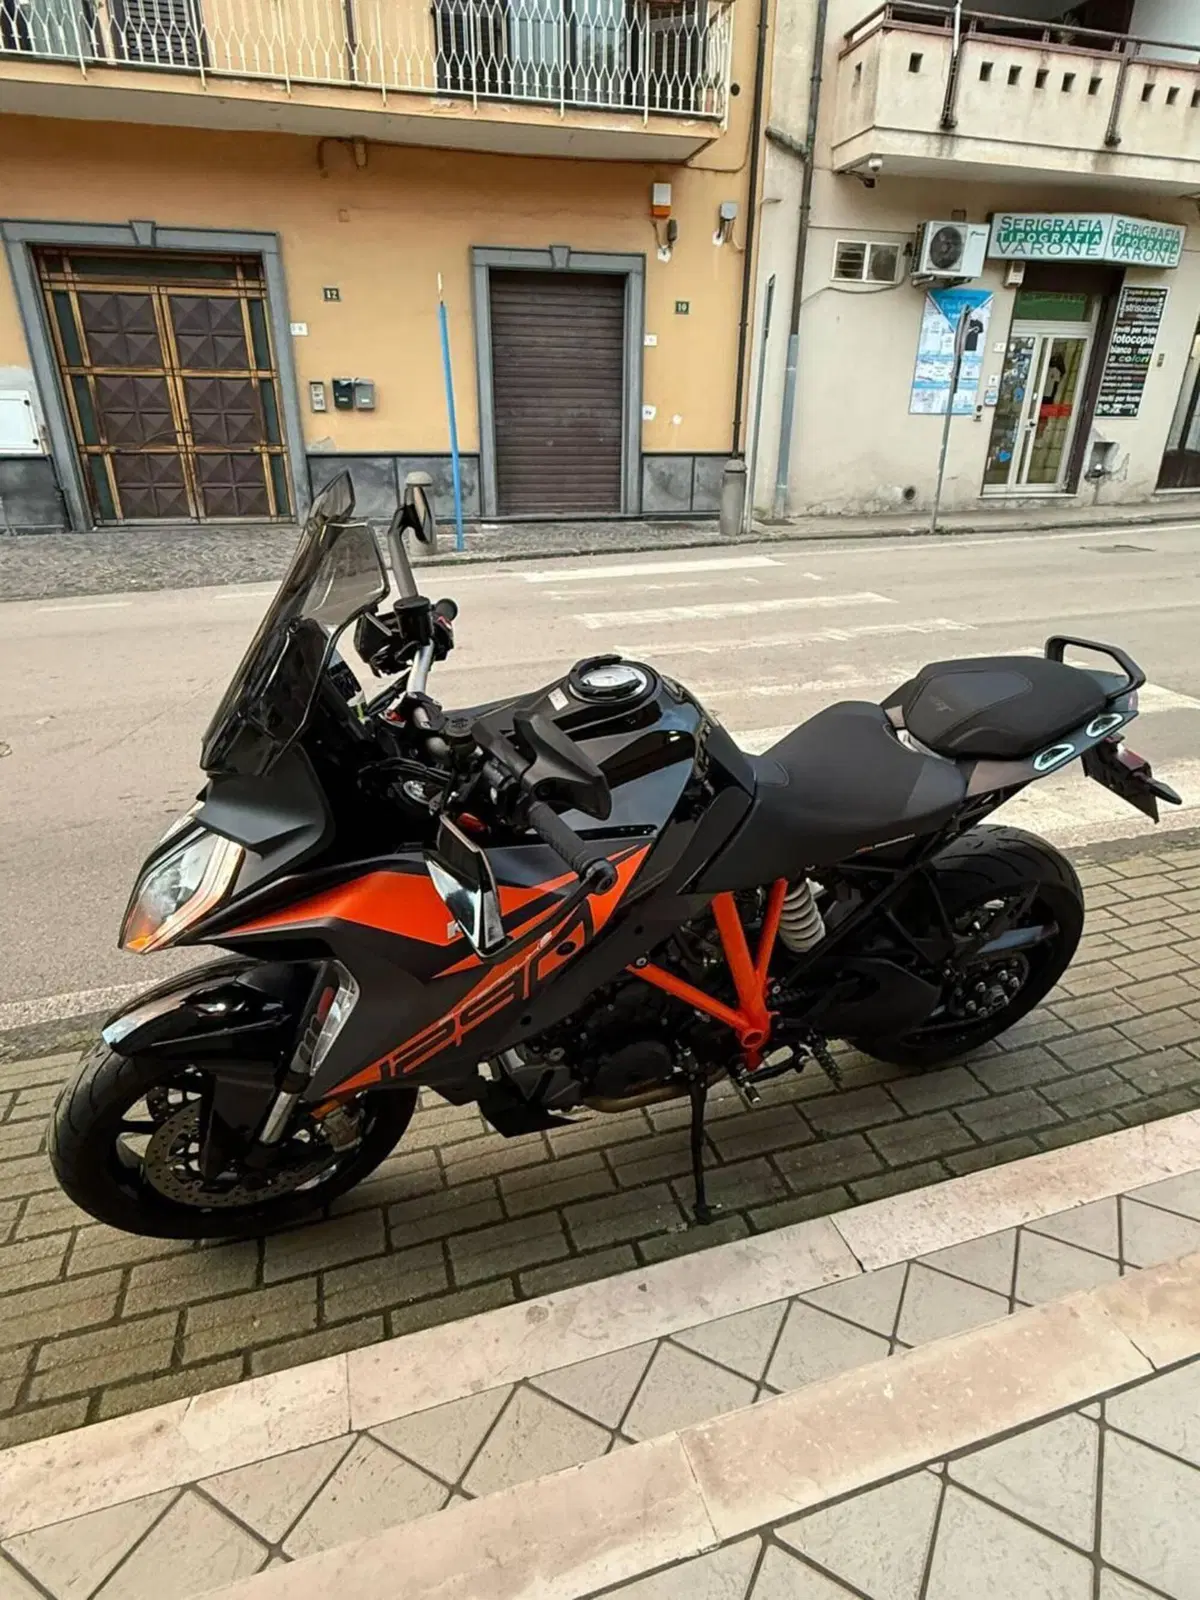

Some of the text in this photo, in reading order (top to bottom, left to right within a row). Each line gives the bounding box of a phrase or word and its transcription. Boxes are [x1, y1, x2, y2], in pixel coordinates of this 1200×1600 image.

[1000, 216, 1102, 231] SERIGRAFIA
[1115, 220, 1181, 241] SERIGRAFIA
[999, 231, 1101, 244] TIPOGRAFIA
[1114, 234, 1179, 252] TIPOGRAFIA
[998, 241, 1099, 256] VARONE
[1112, 245, 1177, 264] VARONE
[326, 290, 338, 299] 12
[1113, 333, 1155, 346] fotocopie
[1109, 345, 1132, 354] bianco
[1118, 354, 1150, 363] colori
